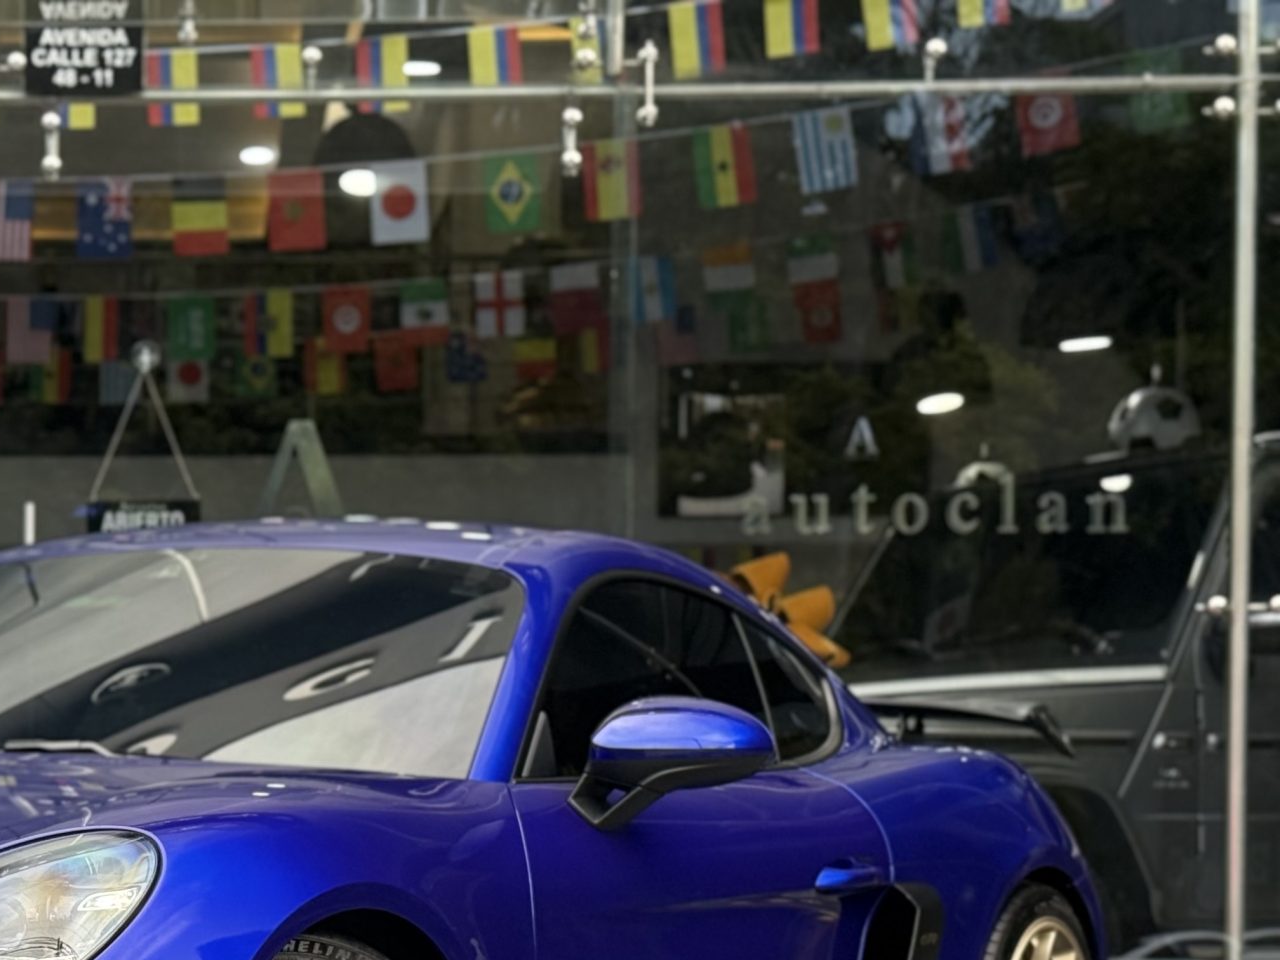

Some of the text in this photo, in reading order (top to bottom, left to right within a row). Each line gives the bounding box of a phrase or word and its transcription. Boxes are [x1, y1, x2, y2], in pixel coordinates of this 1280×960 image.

[39, 27, 129, 47] AVENIDA
[31, 47, 137, 67] CALLE 127
[92, 68, 114, 88] 11
[741, 473, 1130, 535] autoclan
